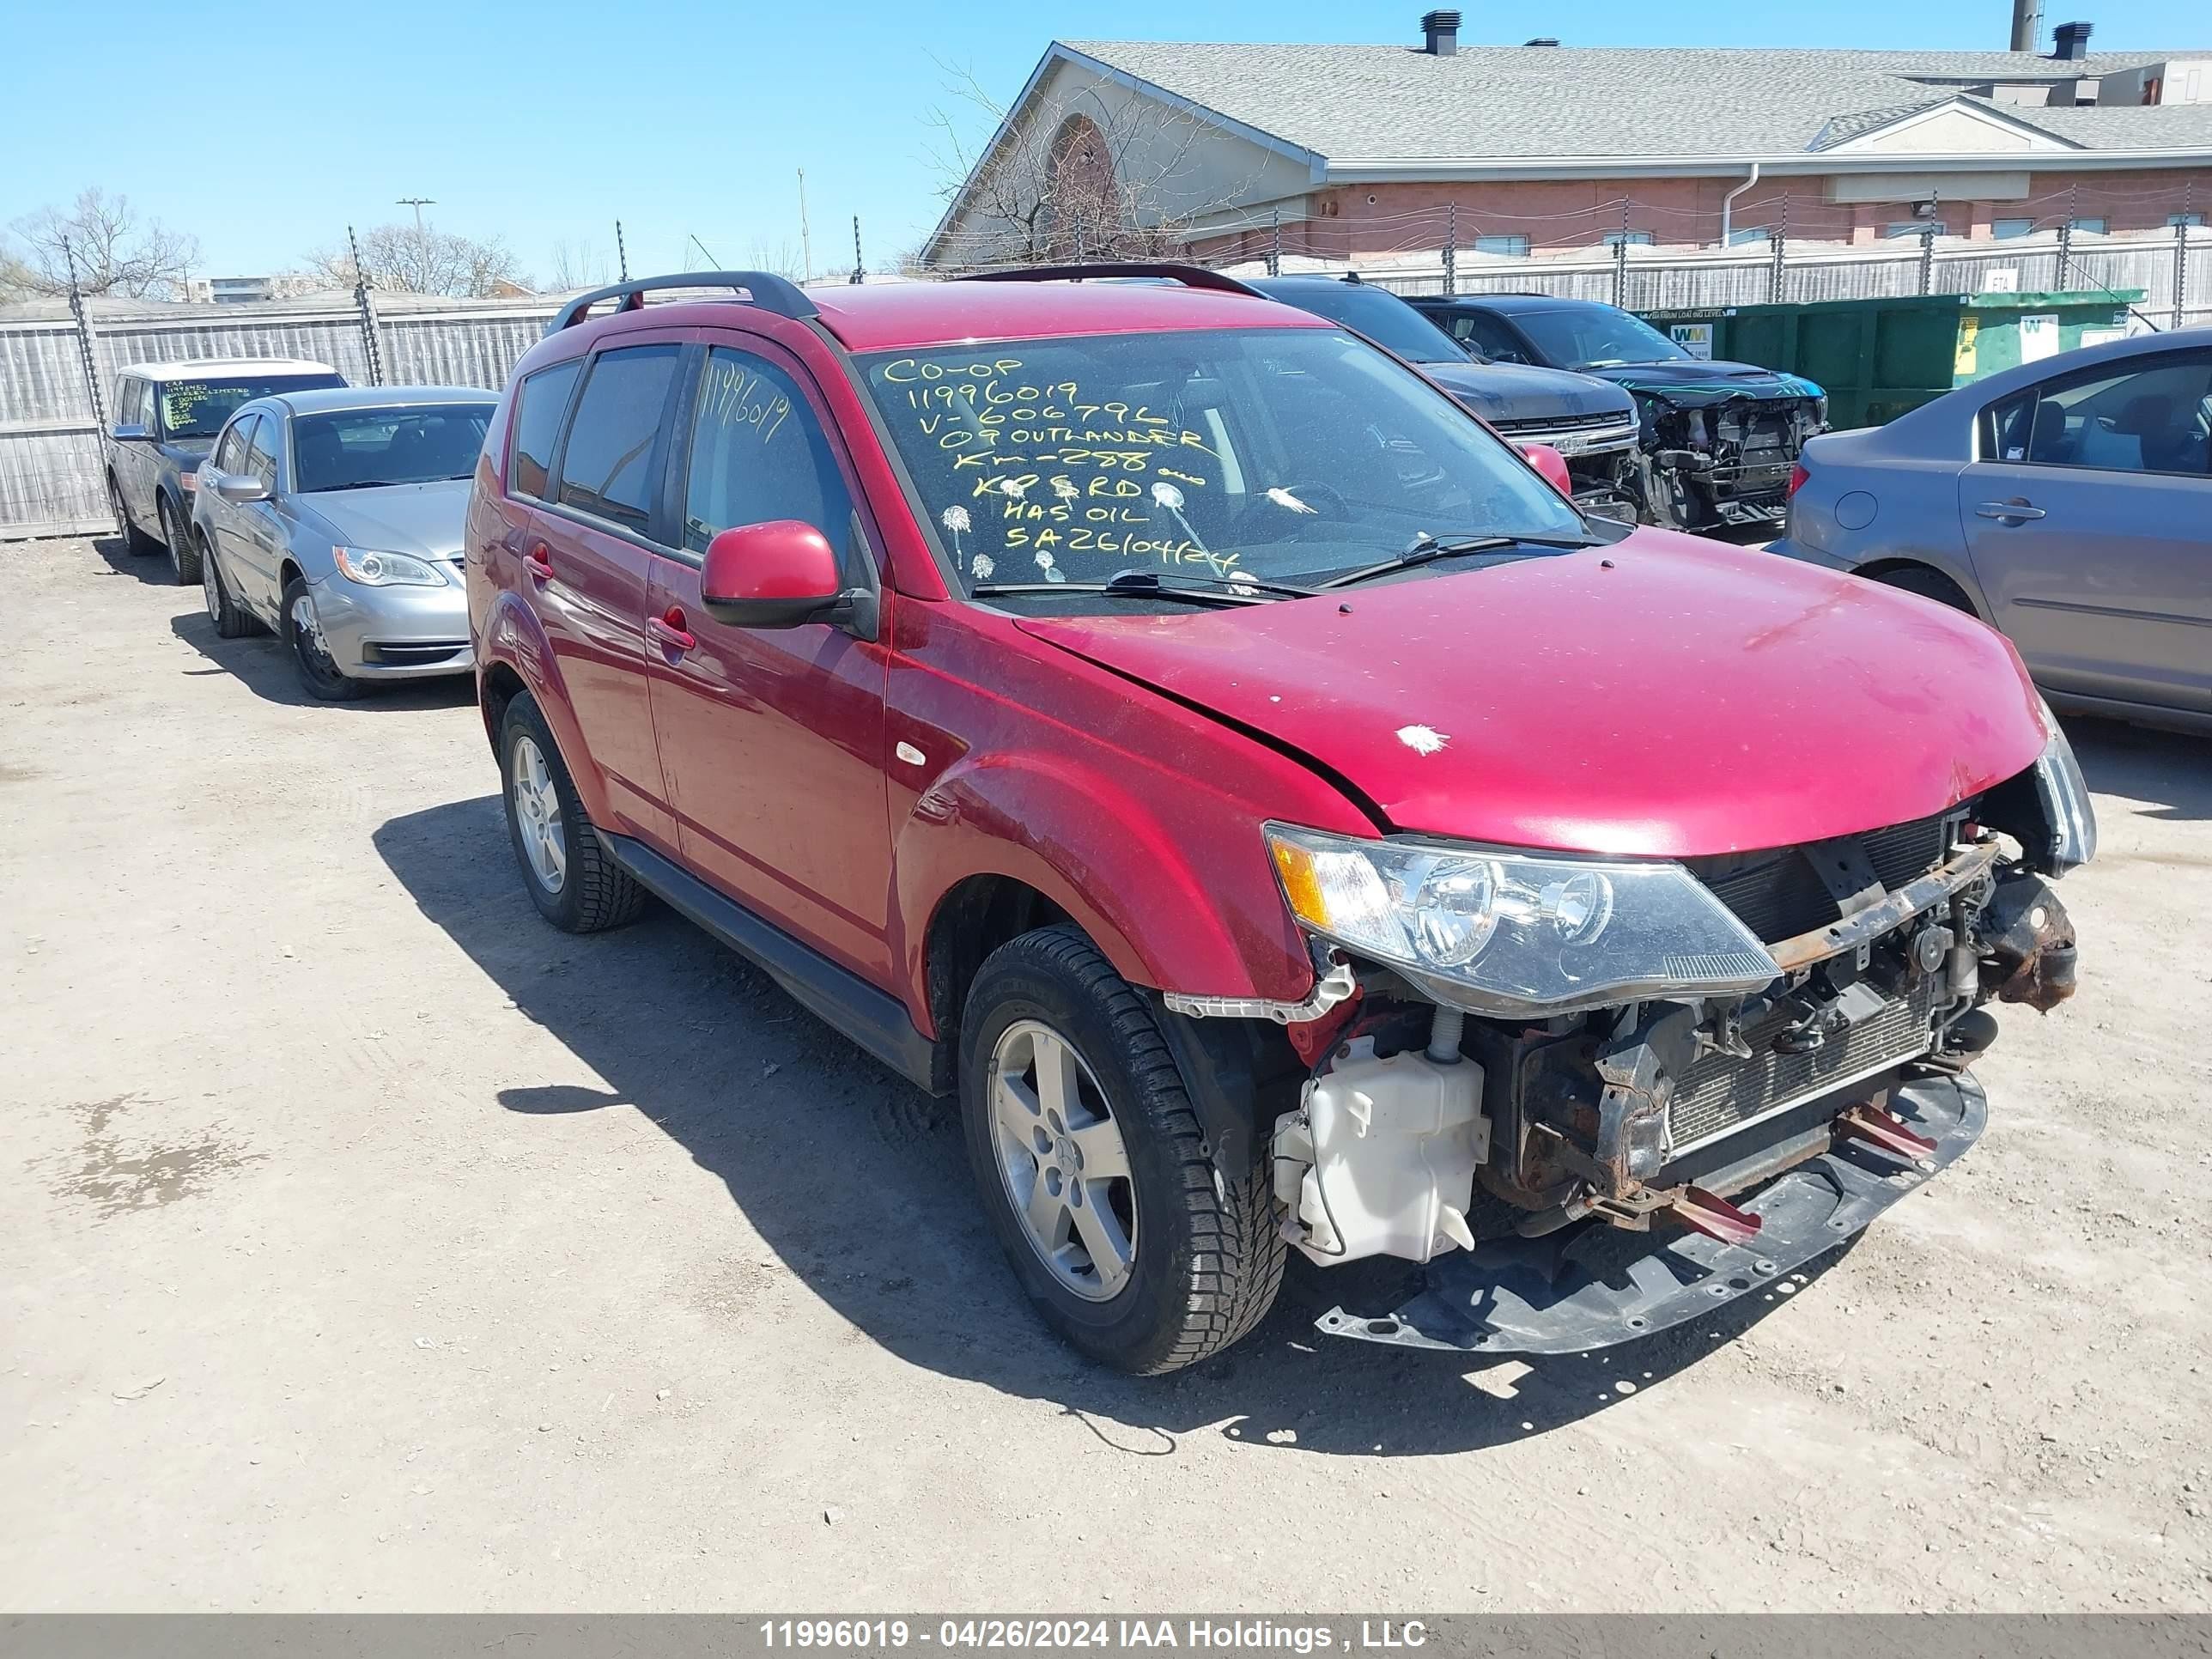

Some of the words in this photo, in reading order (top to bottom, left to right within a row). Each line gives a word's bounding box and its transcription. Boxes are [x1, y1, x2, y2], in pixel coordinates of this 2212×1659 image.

[1674, 328, 1707, 342] WM
[884, 358, 1024, 382] CO-OP
[702, 362, 791, 445] 11996019
[908, 380, 1078, 410] 11996019
[1011, 428, 1224, 460] OUTLANDER
[1004, 501, 1070, 521] HAS
[1085, 507, 1151, 523] OIL
